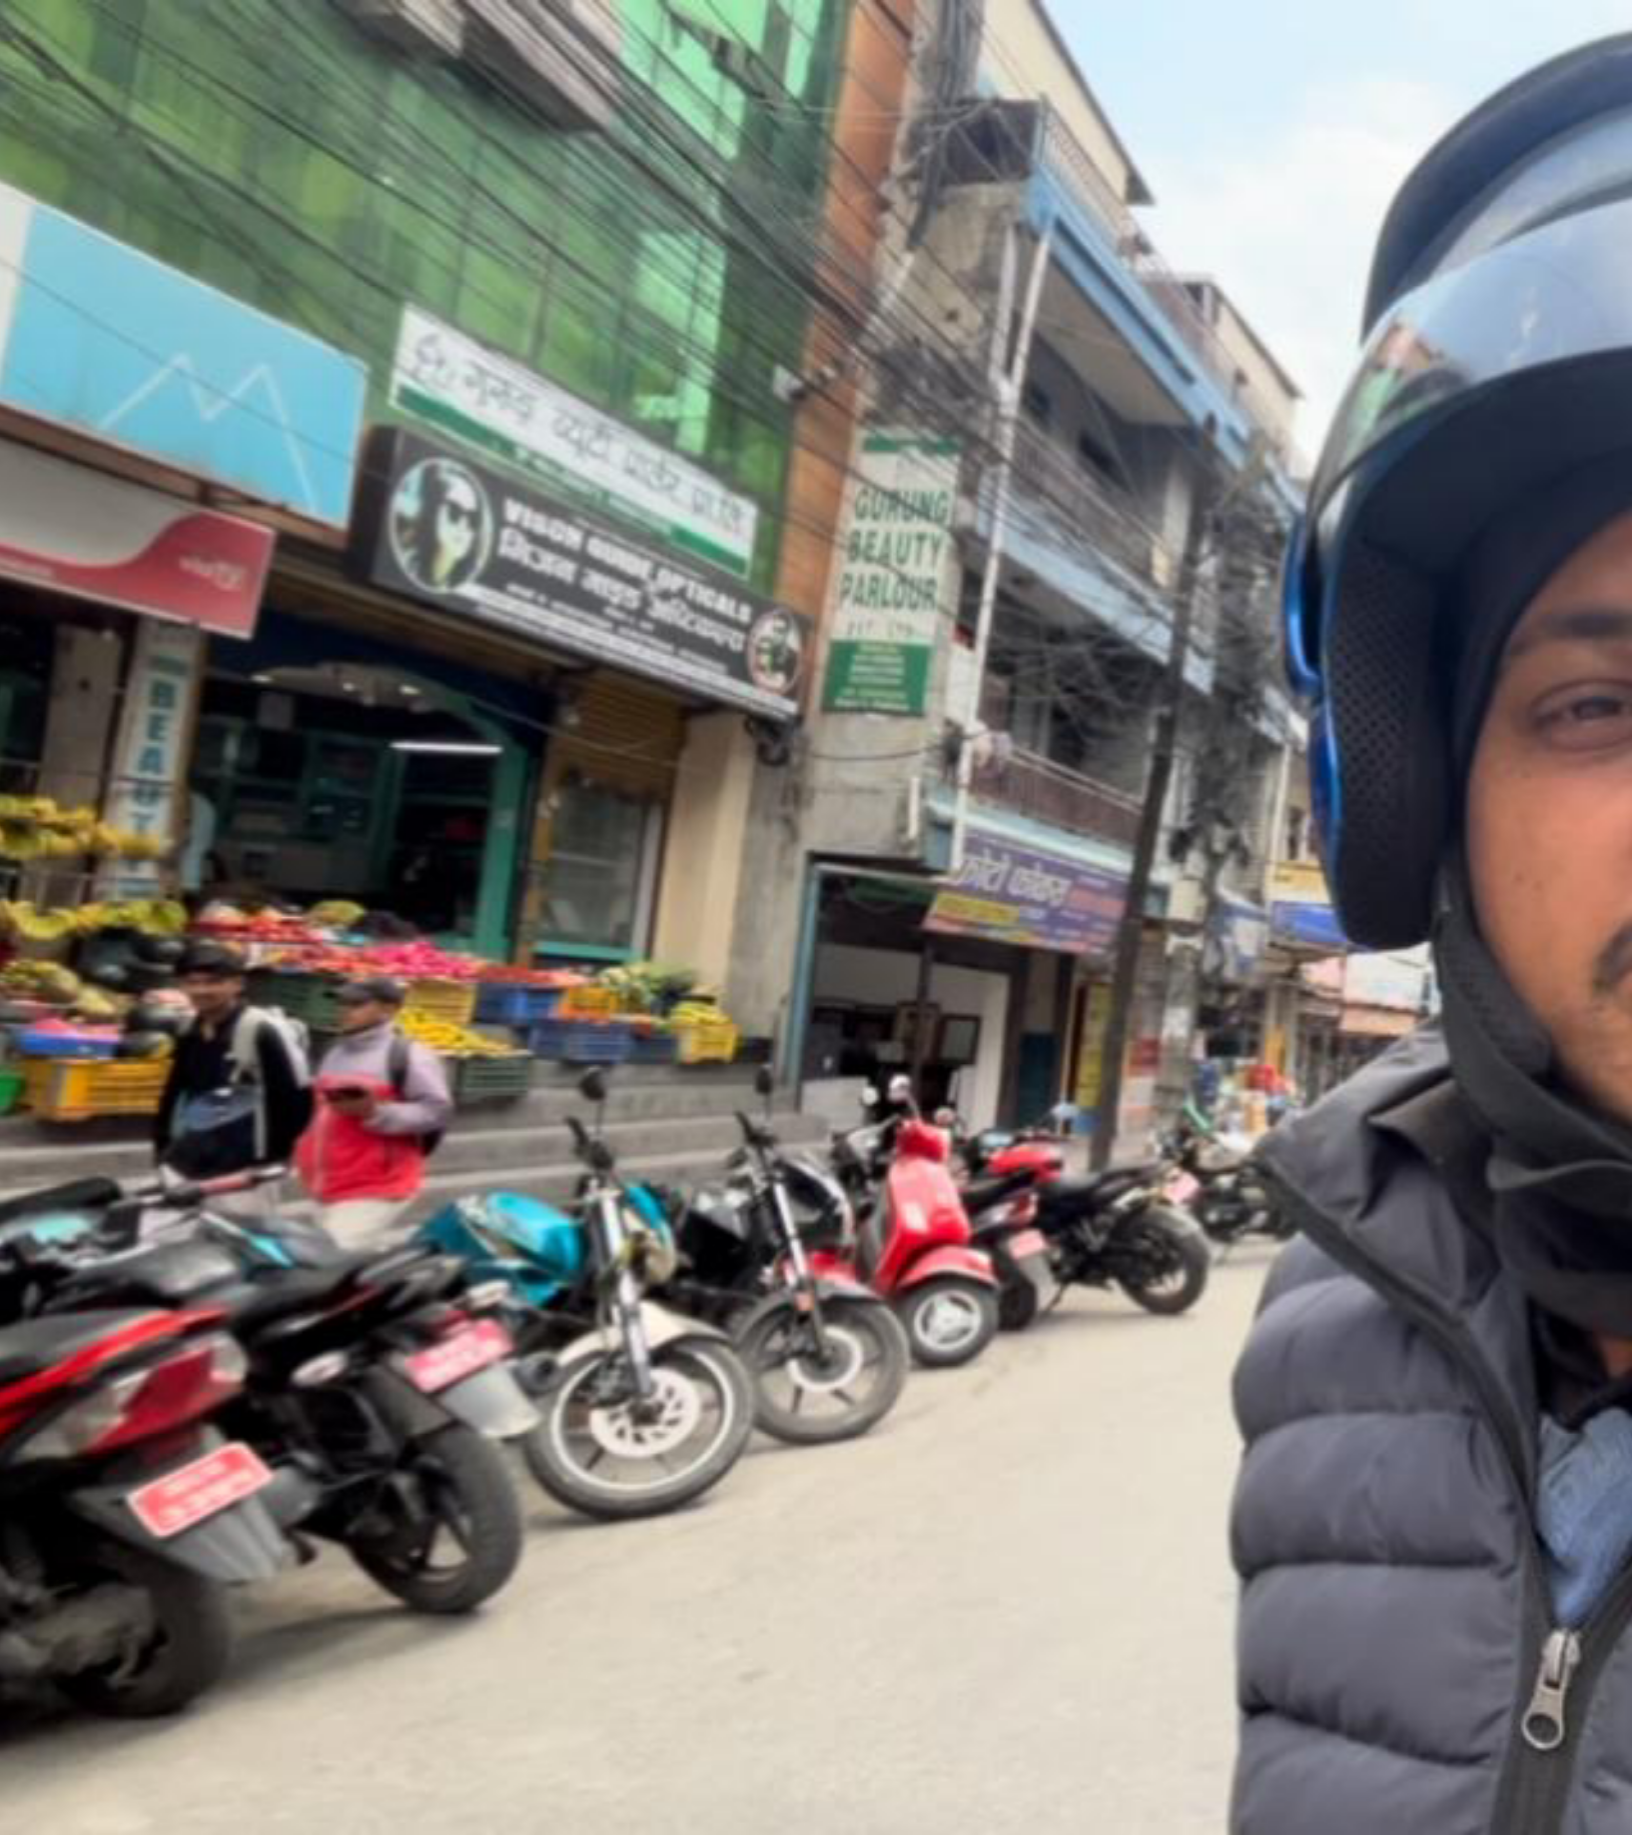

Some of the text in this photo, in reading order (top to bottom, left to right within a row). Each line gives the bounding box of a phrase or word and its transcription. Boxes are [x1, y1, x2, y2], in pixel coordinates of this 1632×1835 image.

[854, 486, 949, 523] GURUNG
[849, 528, 945, 568] BEAUTY
[839, 572, 938, 611] PARLOUR
